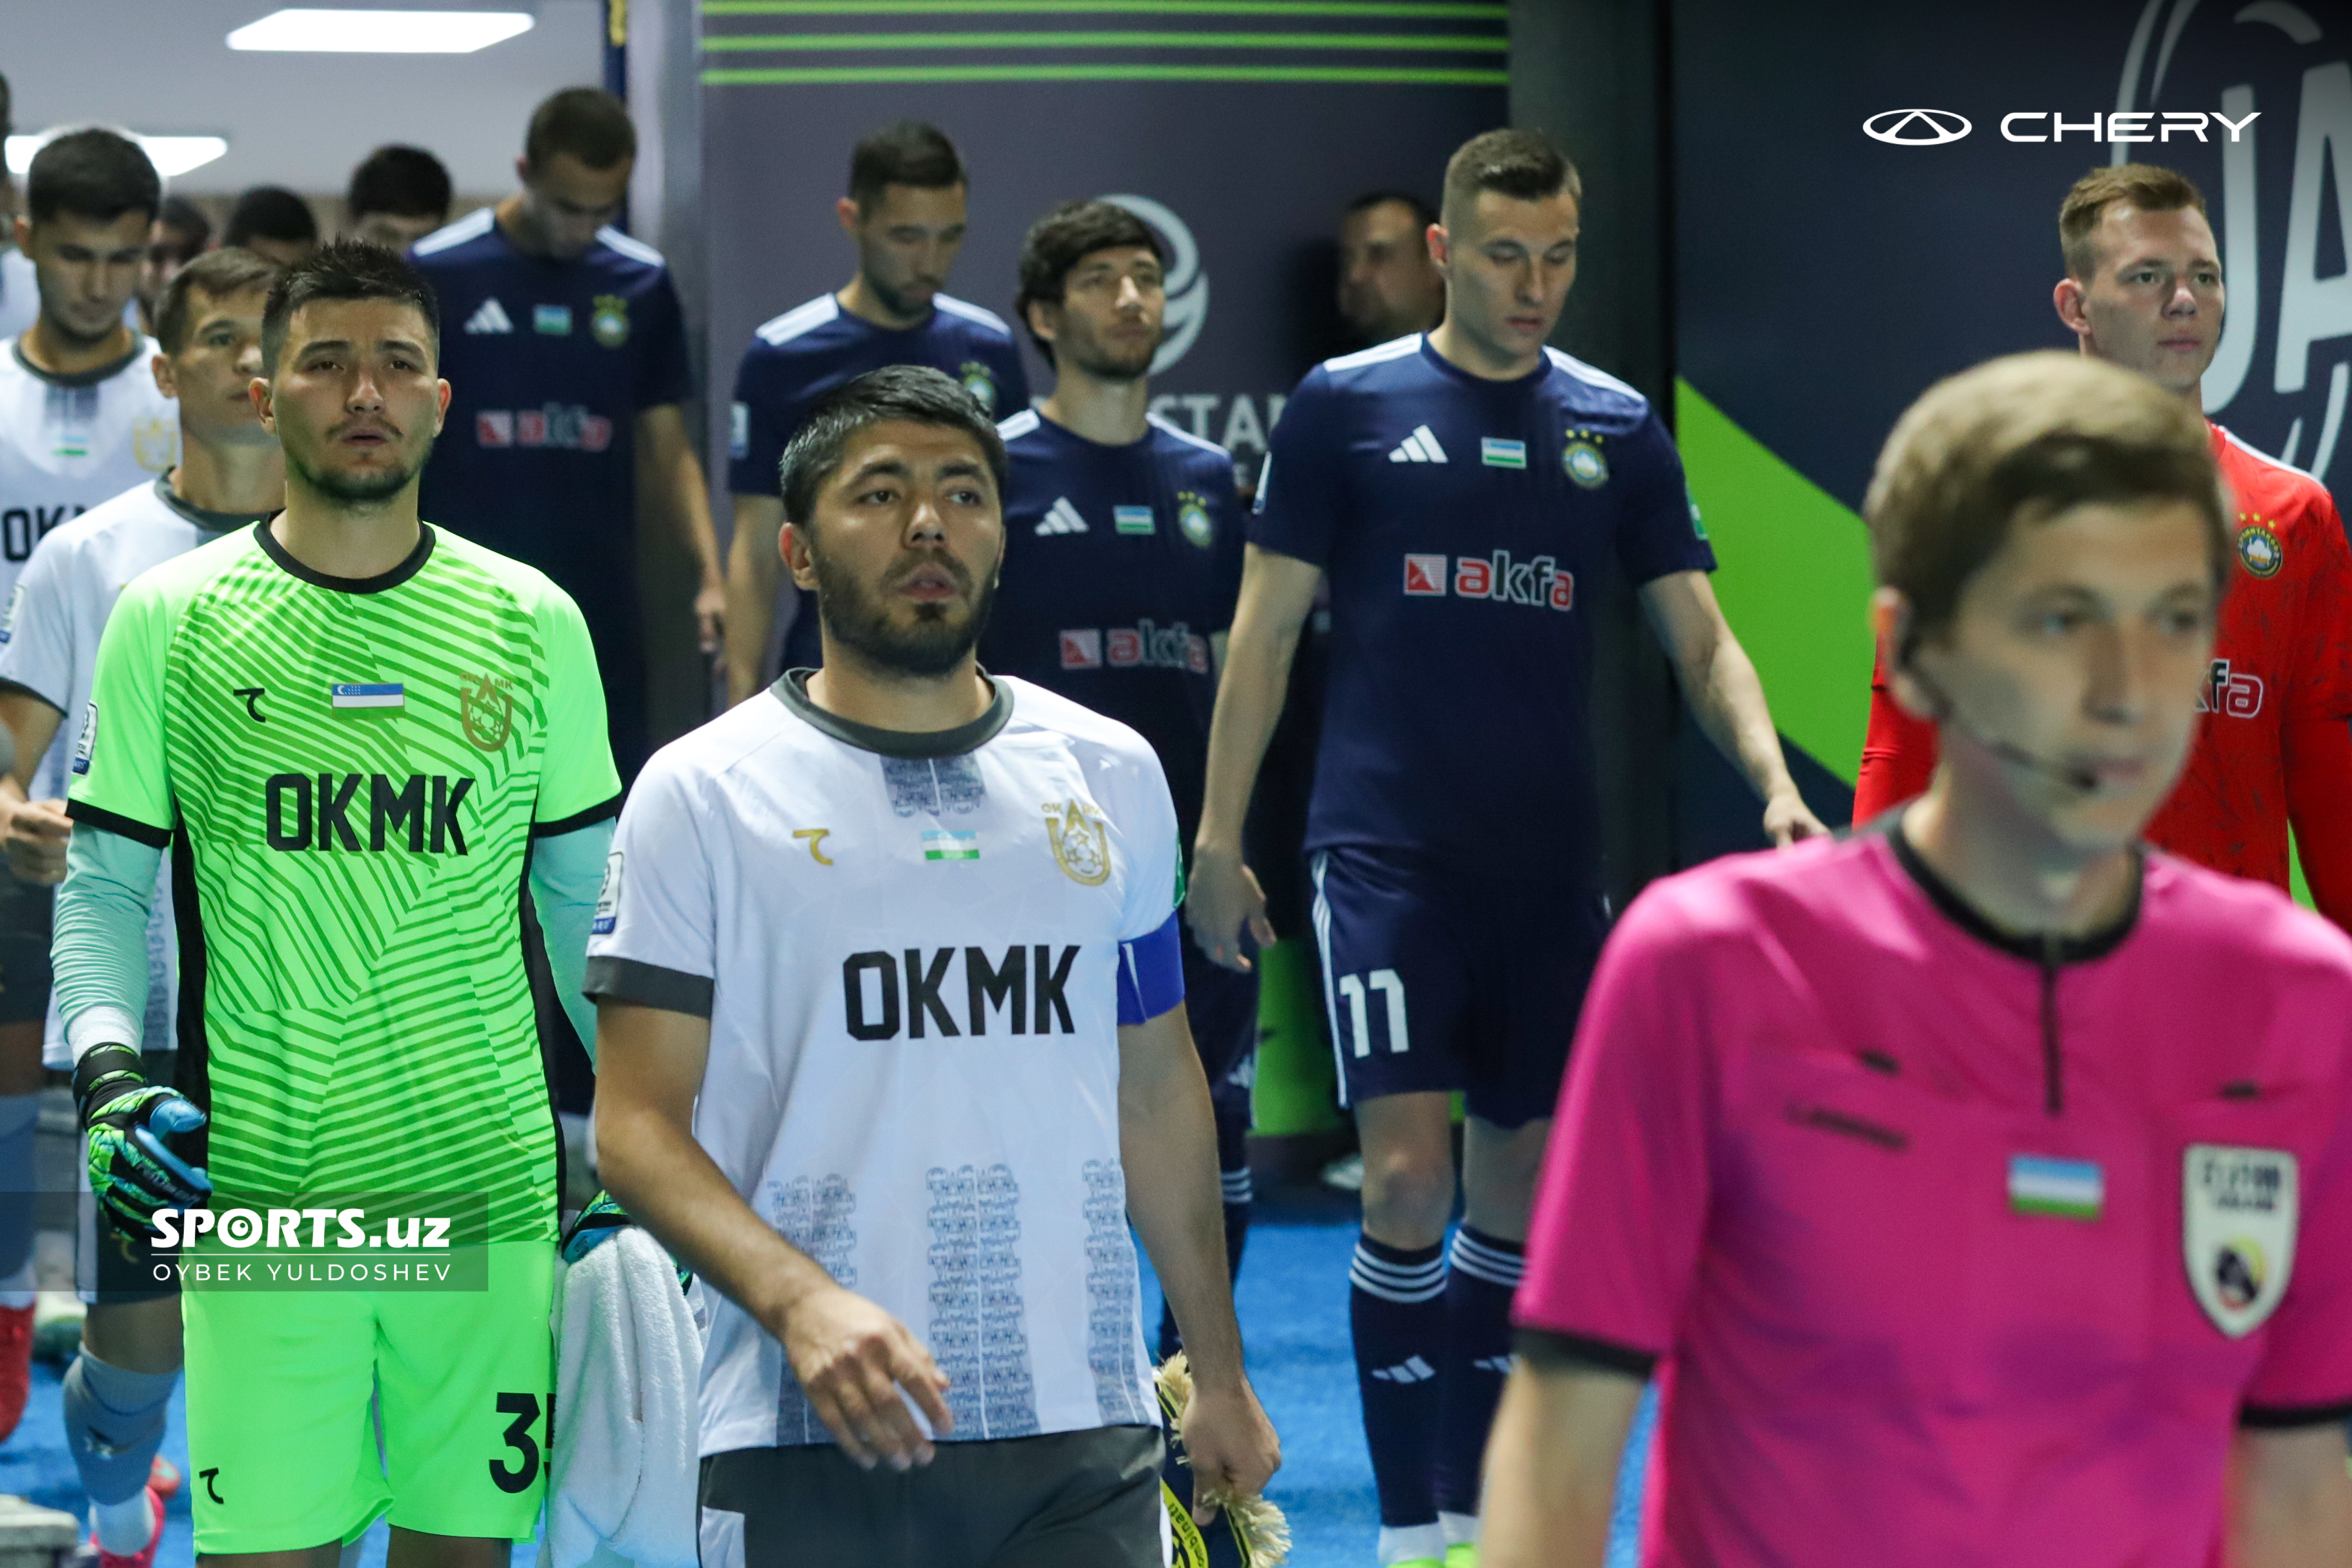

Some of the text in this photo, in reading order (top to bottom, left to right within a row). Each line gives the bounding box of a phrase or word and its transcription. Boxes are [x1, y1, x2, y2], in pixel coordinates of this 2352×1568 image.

[3, 505, 86, 562] OK
[1455, 550, 1574, 612] akfa
[266, 773, 475, 856] OKMK
[843, 944, 1081, 1042] OKMK
[1339, 969, 1409, 1058] 11
[1168, 1502, 1204, 1568] ombinati
